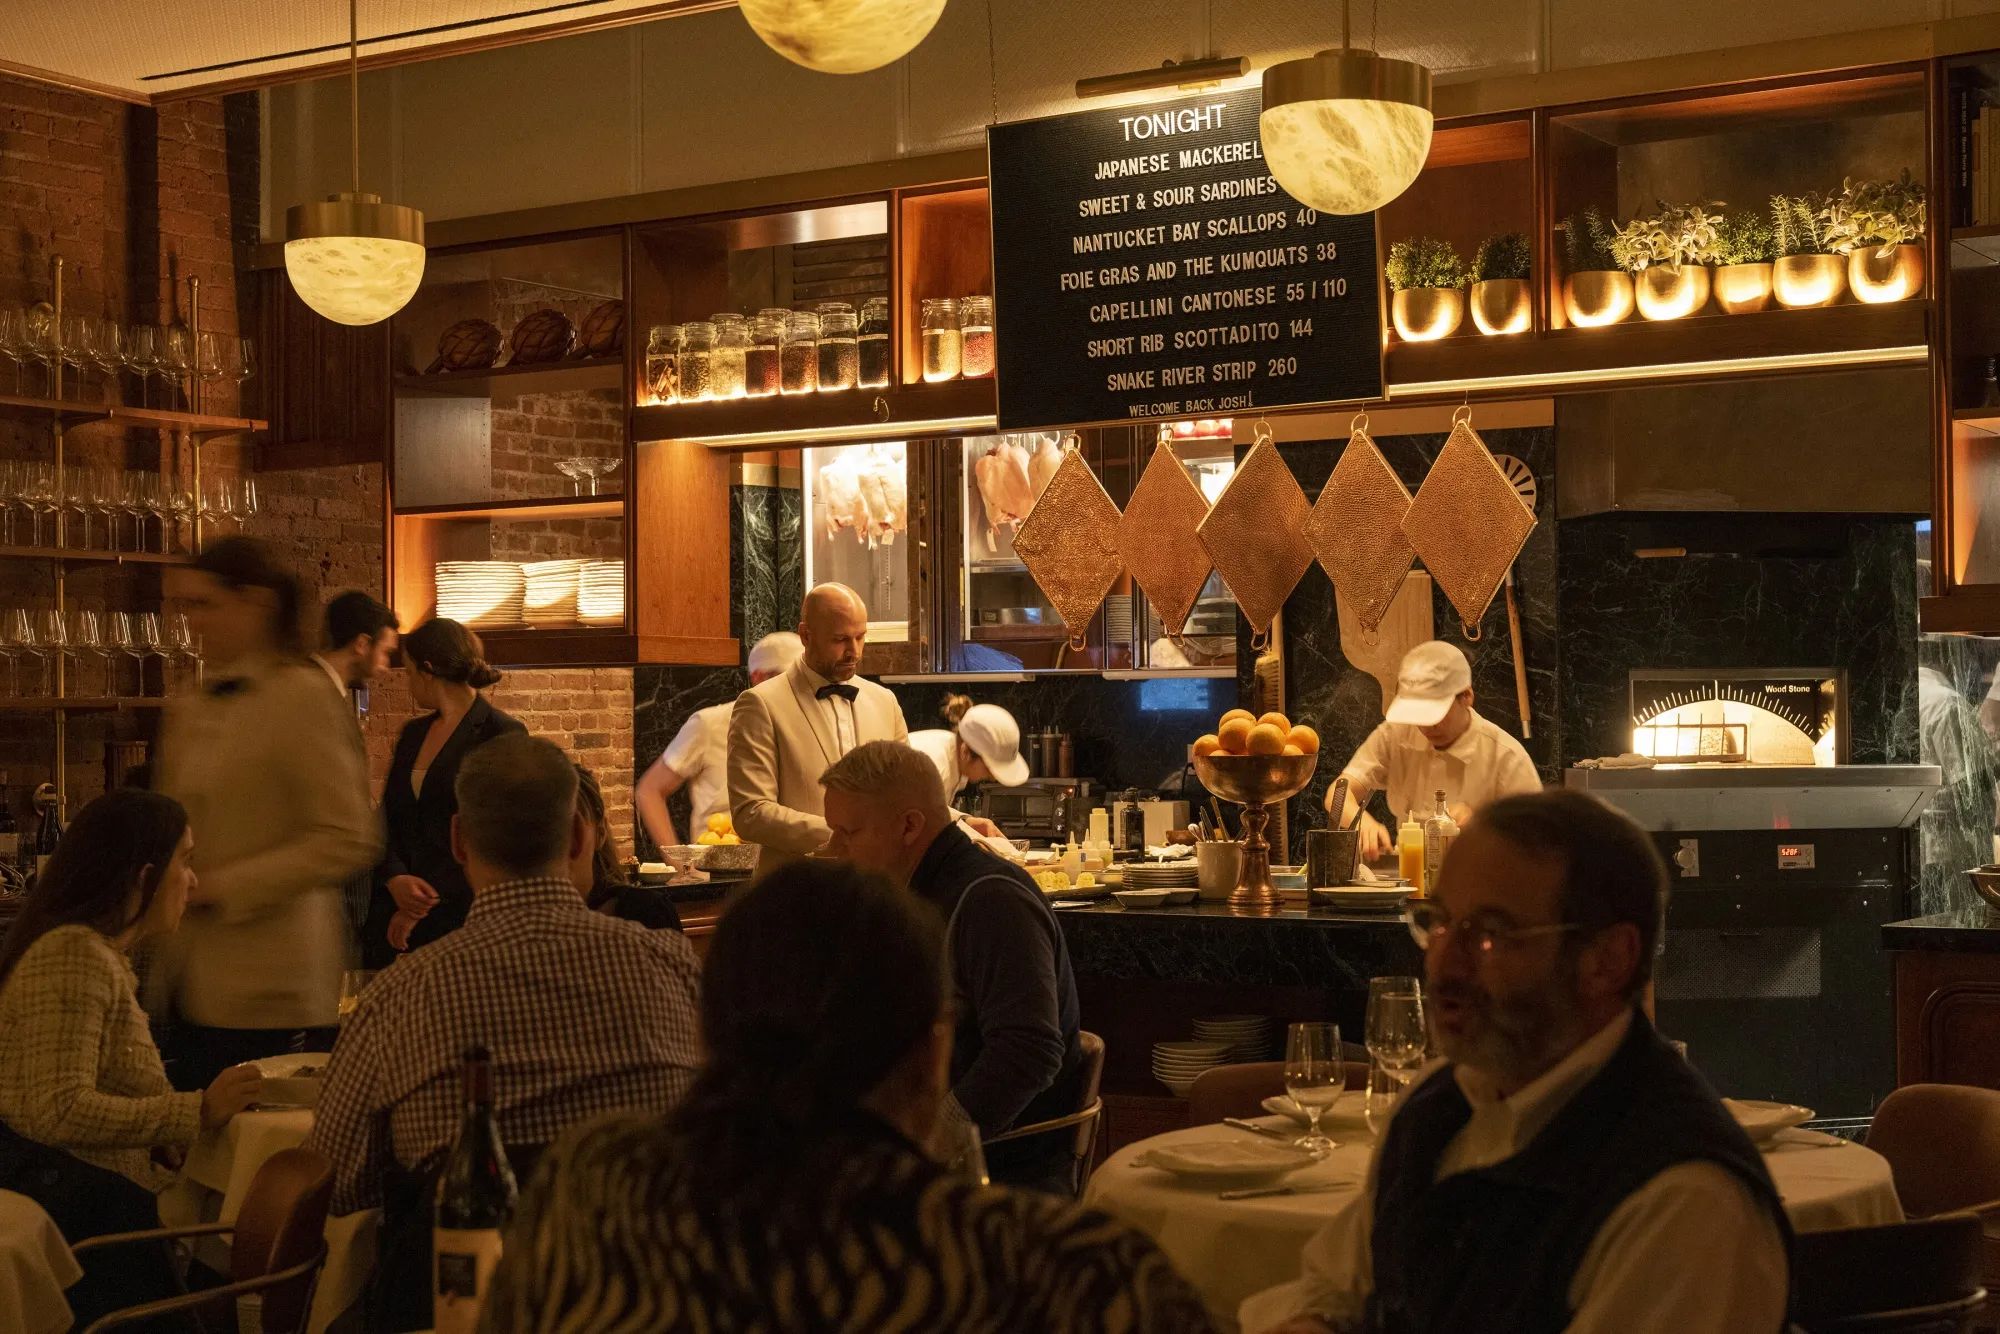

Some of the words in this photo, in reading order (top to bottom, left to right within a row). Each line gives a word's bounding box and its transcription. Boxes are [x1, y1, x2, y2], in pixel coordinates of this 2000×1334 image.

[1119, 103, 1227, 142] TONIGHT
[1095, 153, 1170, 179] JAPANESE
[1180, 141, 1262, 168] MACKEREL
[1080, 195, 1129, 217] SWEET
[1136, 193, 1146, 209] &
[1154, 187, 1194, 207] SOUR
[1200, 176, 1277, 201] SARDINES
[1074, 226, 1165, 253] NANTUCKET
[1173, 222, 1200, 241] BAY
[1208, 212, 1286, 237] SCALLOPS
[1297, 208, 1316, 227] 40
[1061, 271, 1094, 290] FOIE
[1100, 266, 1139, 285] GRAS
[1147, 262, 1176, 280] AND
[1184, 257, 1213, 276] THE
[1221, 246, 1307, 272] KUMQUATS
[1317, 242, 1336, 260] 38
[1090, 297, 1172, 322] CAPELLINI
[1182, 286, 1275, 312] CANTONESE
[1287, 283, 1304, 301] 55
[1312, 281, 1316, 299] /
[1323, 278, 1346, 297] 110
[1088, 337, 1134, 357] SHORT
[1141, 334, 1164, 352] RIB
[1174, 322, 1279, 349] SCOTTADITO
[1290, 319, 1312, 337] 144
[1108, 371, 1154, 391] SNAKE
[1162, 366, 1205, 386] RIVER
[1213, 361, 1256, 381] STRIP
[1269, 357, 1296, 376] 260
[1129, 402, 1180, 417] WELCOME
[1186, 399, 1214, 412] BACK
[1765, 685, 1787, 693] Wood
[1788, 685, 1810, 693] Stone
